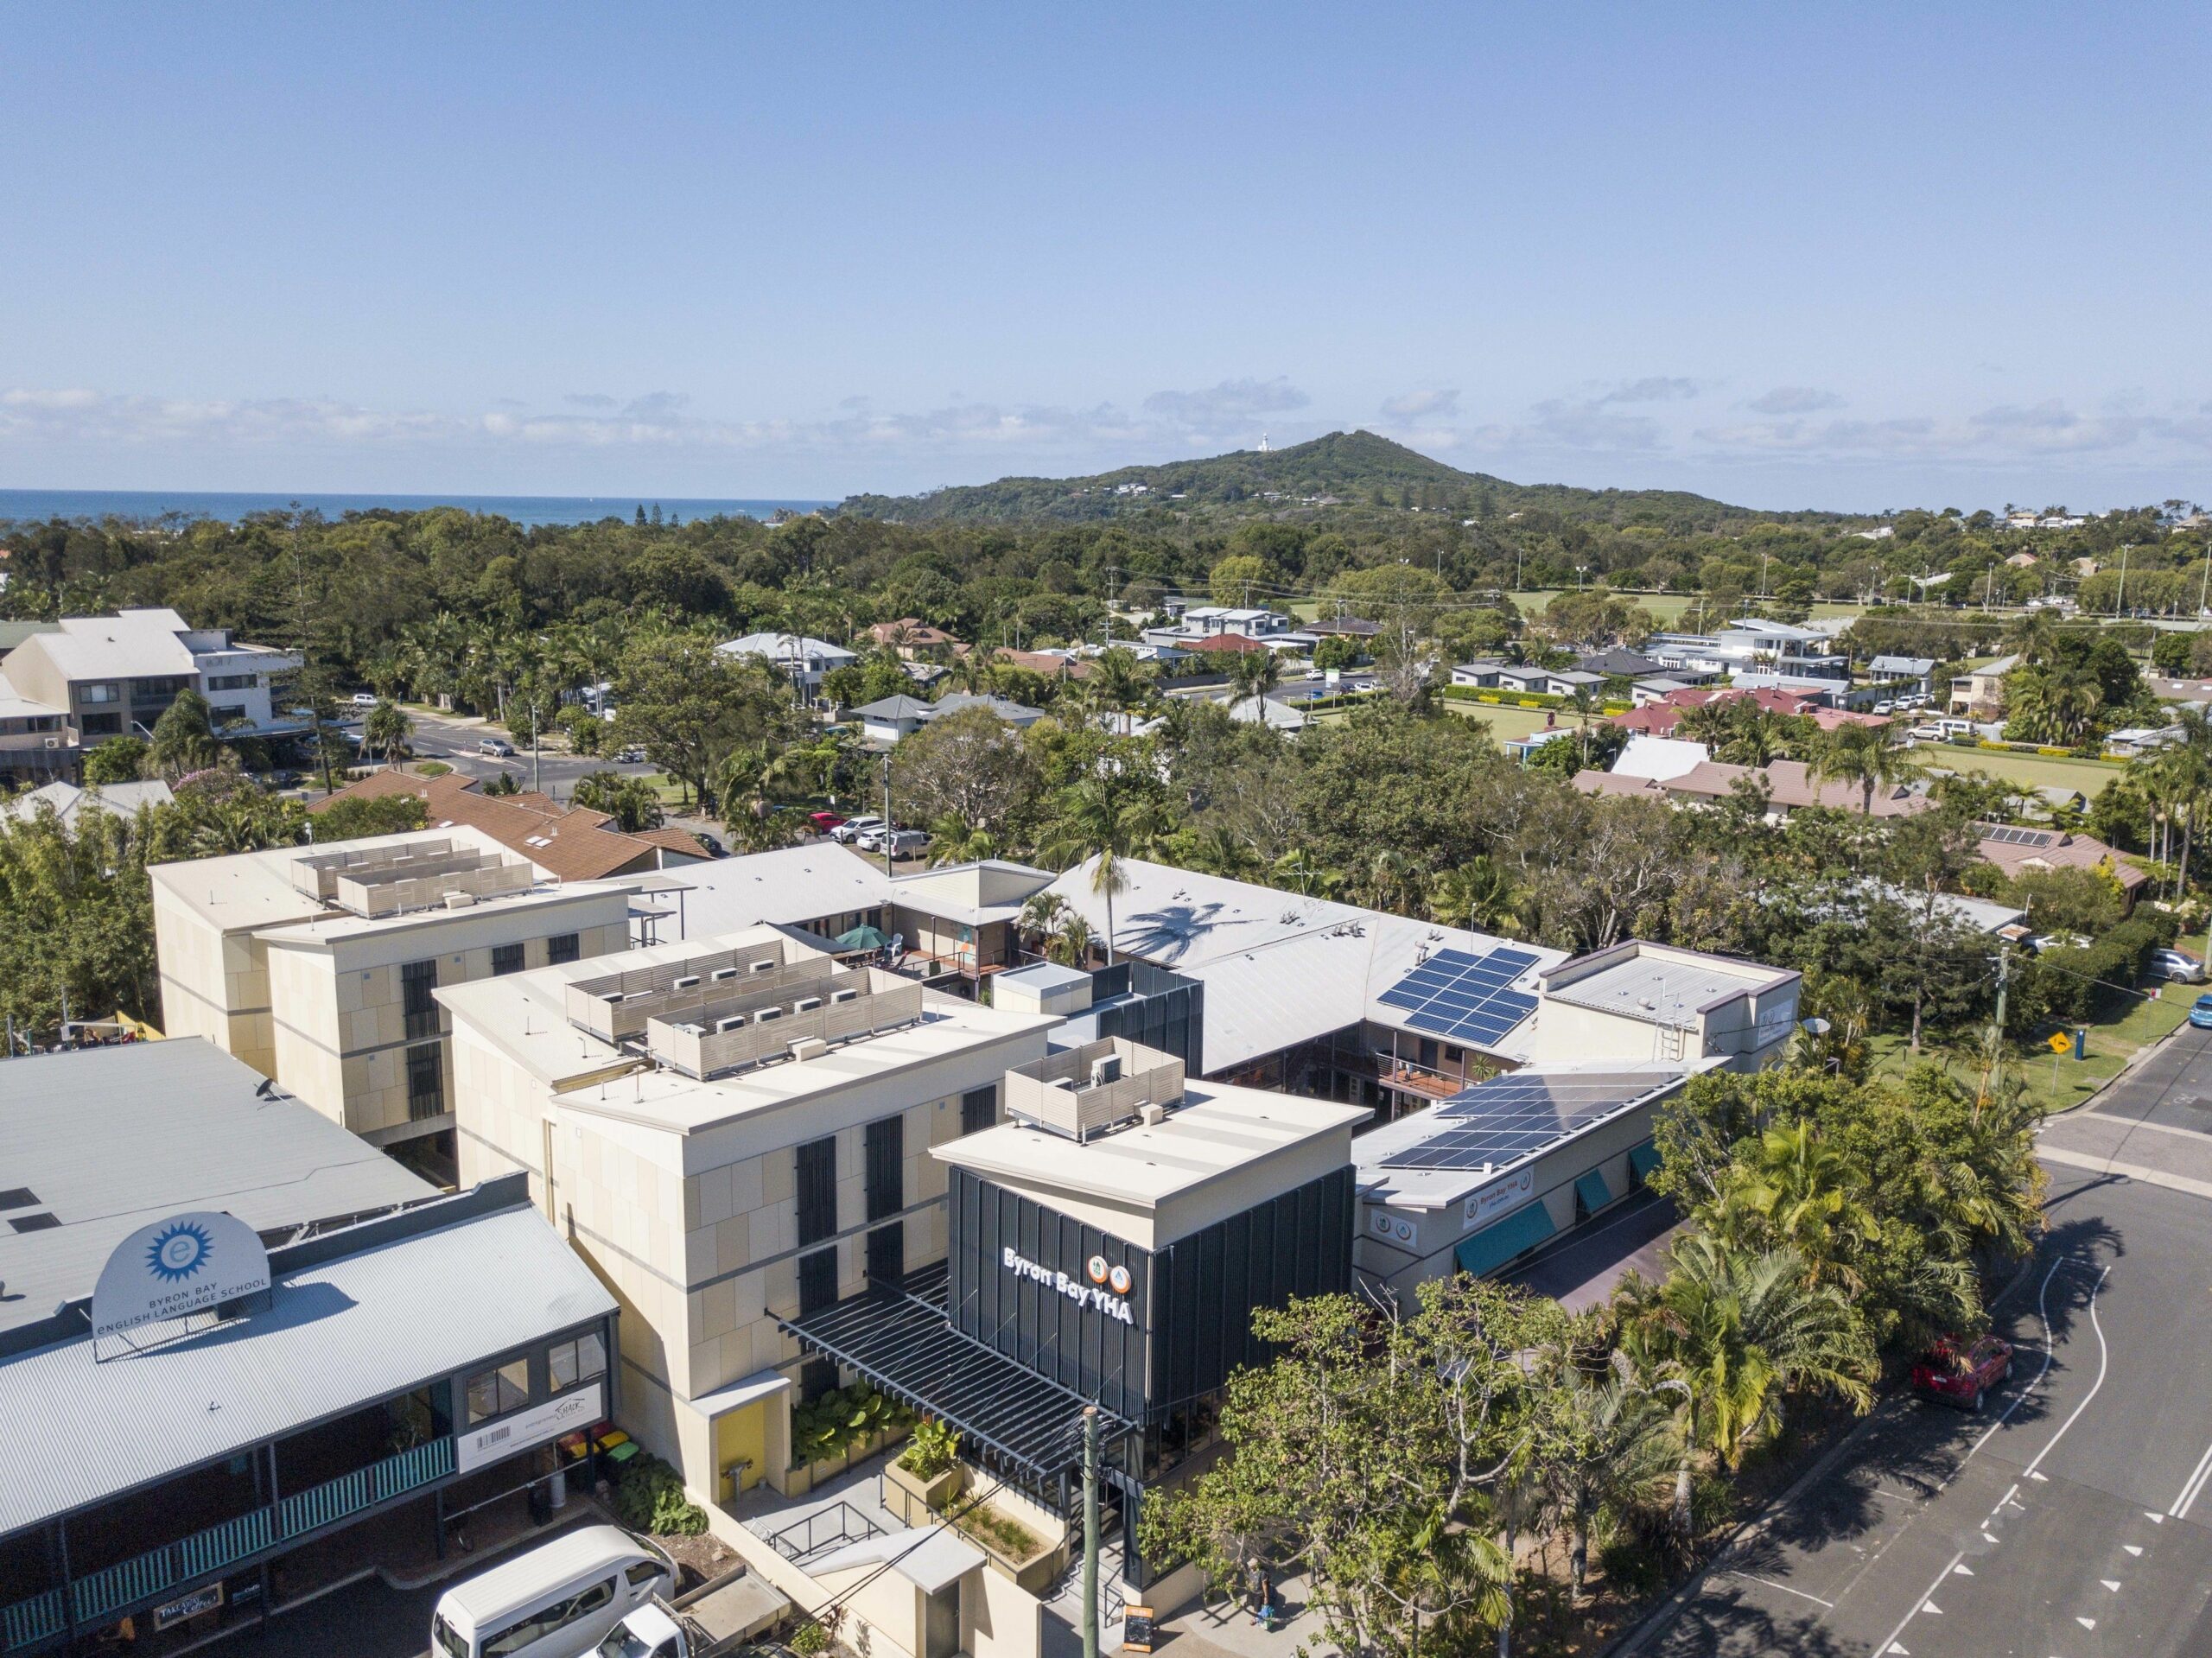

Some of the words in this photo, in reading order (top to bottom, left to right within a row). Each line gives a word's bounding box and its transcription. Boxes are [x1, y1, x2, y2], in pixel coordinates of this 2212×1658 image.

[1480, 1193, 1496, 1204] Byron
[1497, 1187, 1506, 1196] Bay
[1508, 1180, 1517, 1190] YHA
[169, 1241, 190, 1262] e
[149, 1291, 189, 1309] BYRON
[195, 1282, 218, 1295] BAY
[155, 1292, 216, 1318] LANGUAGE
[221, 1278, 266, 1298] SCHOOL
[1004, 1247, 1052, 1286] Byron
[1056, 1271, 1090, 1306] Bay
[1092, 1287, 1134, 1325] YHA
[556, 1401, 585, 1420] SHACK
[161, 1596, 200, 1617] TAKEAWAY
